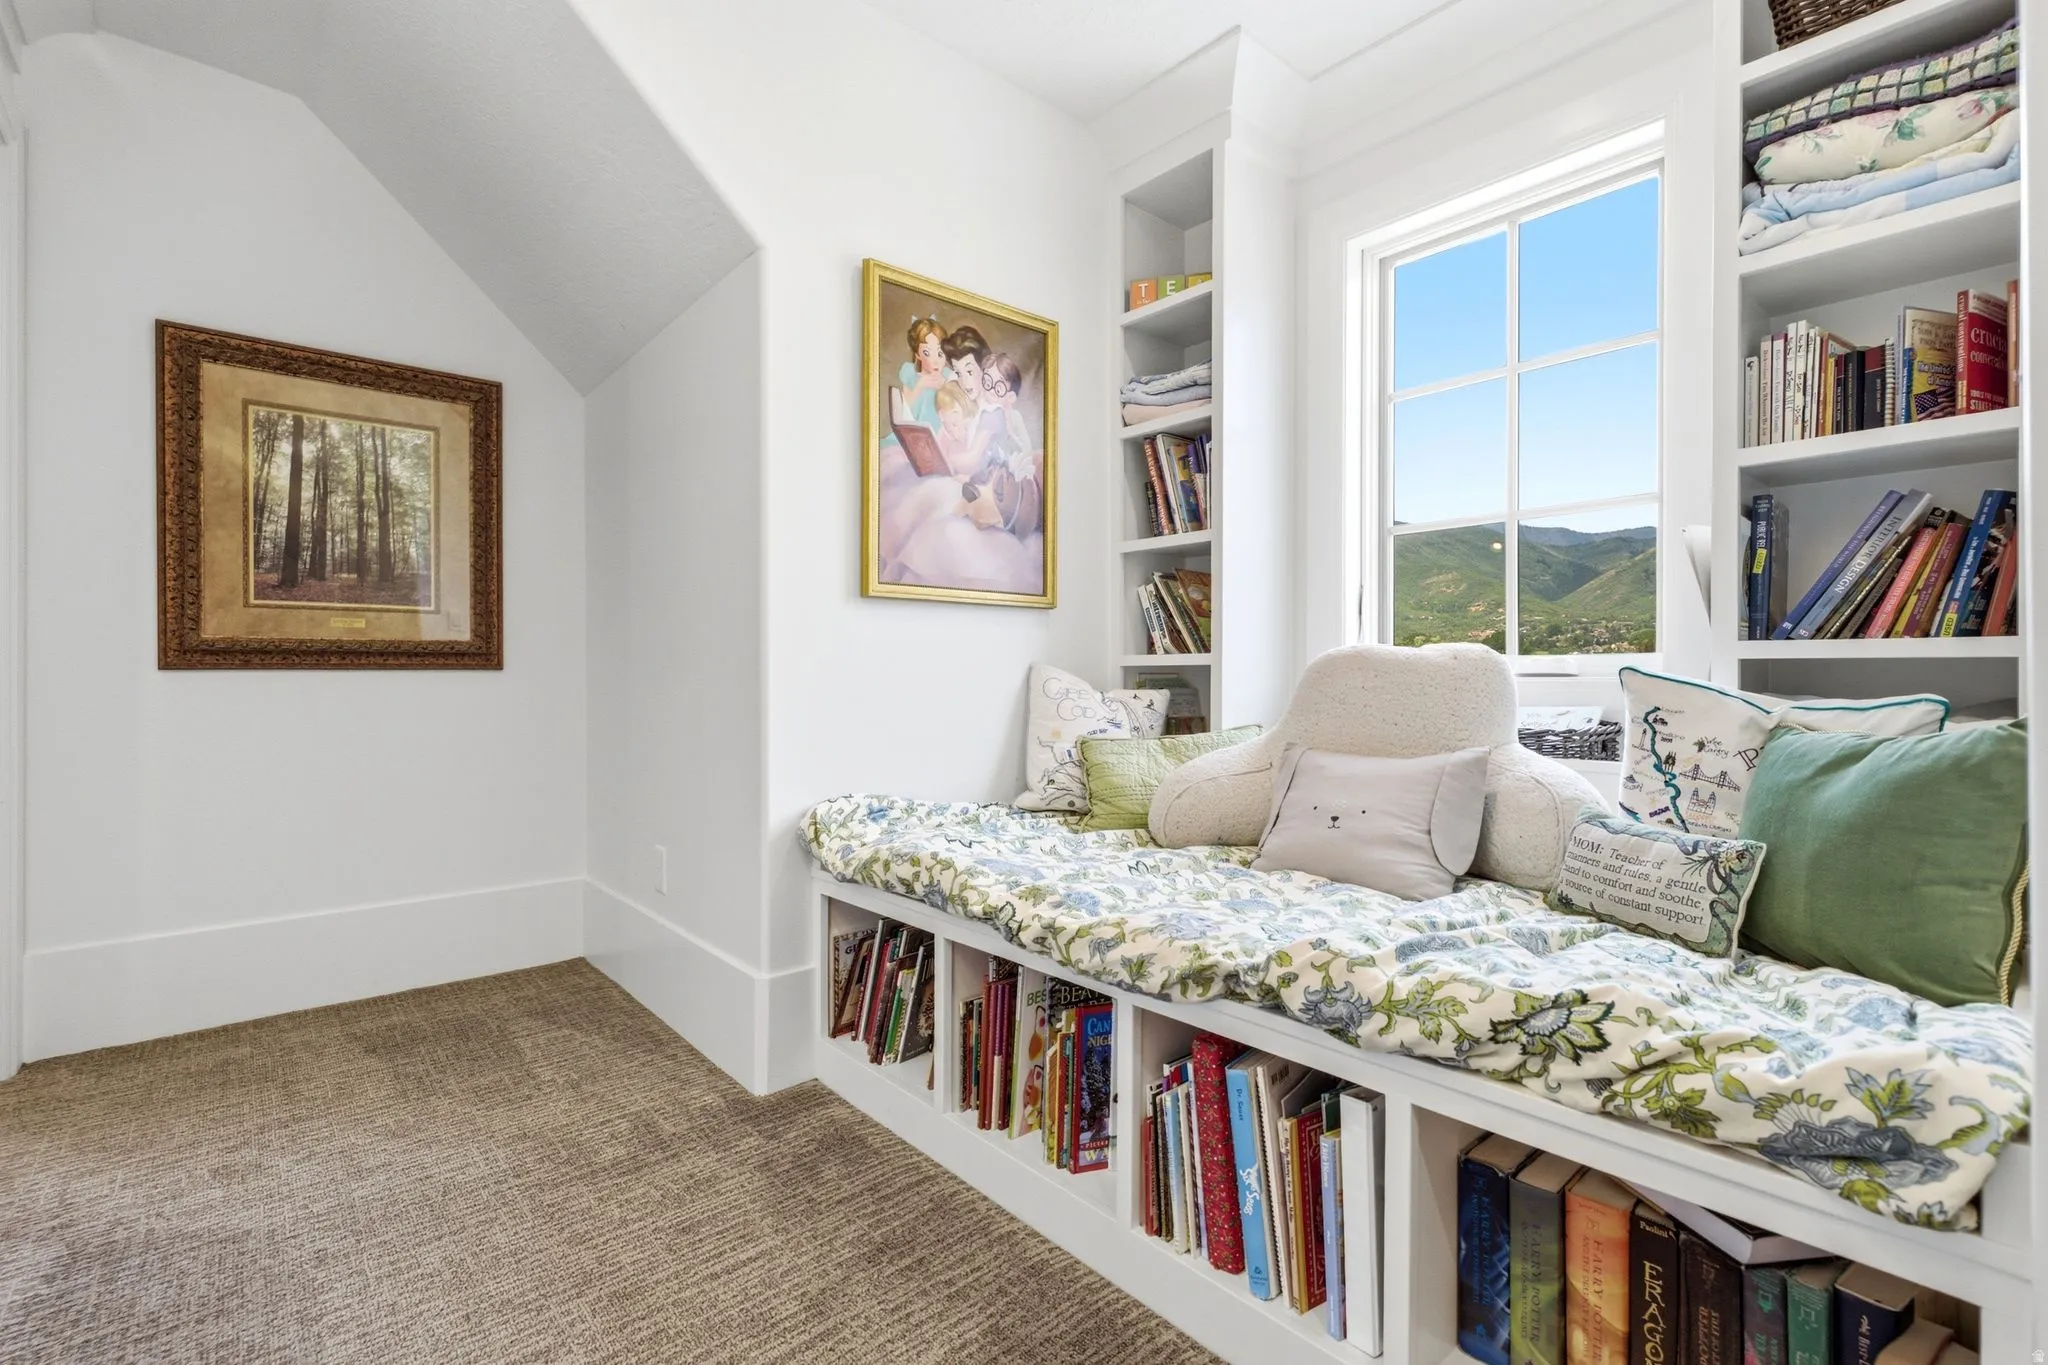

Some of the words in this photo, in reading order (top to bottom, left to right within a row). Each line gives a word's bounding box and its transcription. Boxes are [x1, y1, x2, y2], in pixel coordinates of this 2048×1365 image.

[1757, 521, 1767, 539] PUBLIC
[1862, 516, 1902, 559] INTERIOR
[1835, 559, 1867, 593] DESIGN
[1943, 616, 1954, 636] USED
[1571, 836, 1605, 854] MOM:
[1610, 848, 1651, 868] Teacher
[1652, 858, 1668, 870] of
[1567, 851, 1601, 868] manners
[1603, 863, 1624, 875] and
[1665, 877, 1707, 895] gentle
[1581, 870, 1591, 880] to
[1593, 874, 1634, 892] comfort
[1635, 885, 1657, 898] and
[1565, 878, 1593, 895] source
[1595, 887, 1605, 899] of
[1608, 893, 1653, 913] constant
[1239, 1168, 1251, 1186] Six
[1243, 1191, 1260, 1216] Seuss
[1480, 1196, 1490, 1250] HARRY
[1639, 1221, 1669, 1238] Paolini
[1530, 1223, 1543, 1283] HARRY
[1592, 1240, 1603, 1300] HARRY
[1480, 1252, 1490, 1306] POTTER
[1528, 1286, 1542, 1343] POTTER
[1592, 1303, 1602, 1363] POTTER
